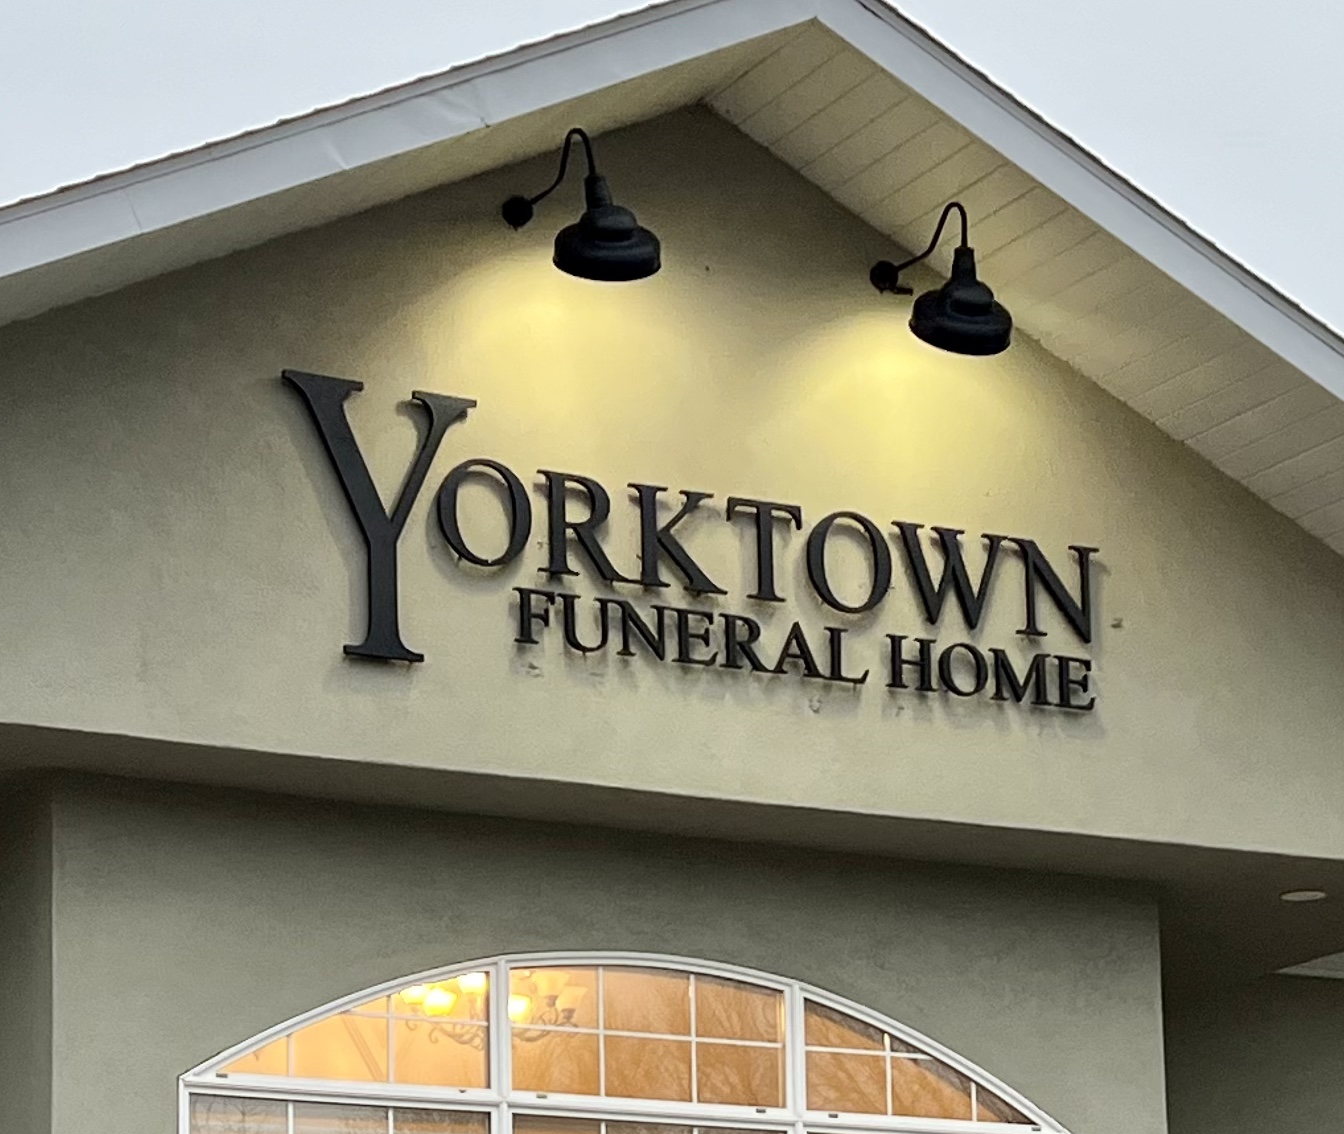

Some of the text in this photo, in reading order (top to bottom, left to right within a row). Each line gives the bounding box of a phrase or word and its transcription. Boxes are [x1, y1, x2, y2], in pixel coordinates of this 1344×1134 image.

[282, 369, 1099, 663] YORKTOWN
[513, 587, 1097, 711] FUNERAL HOME
